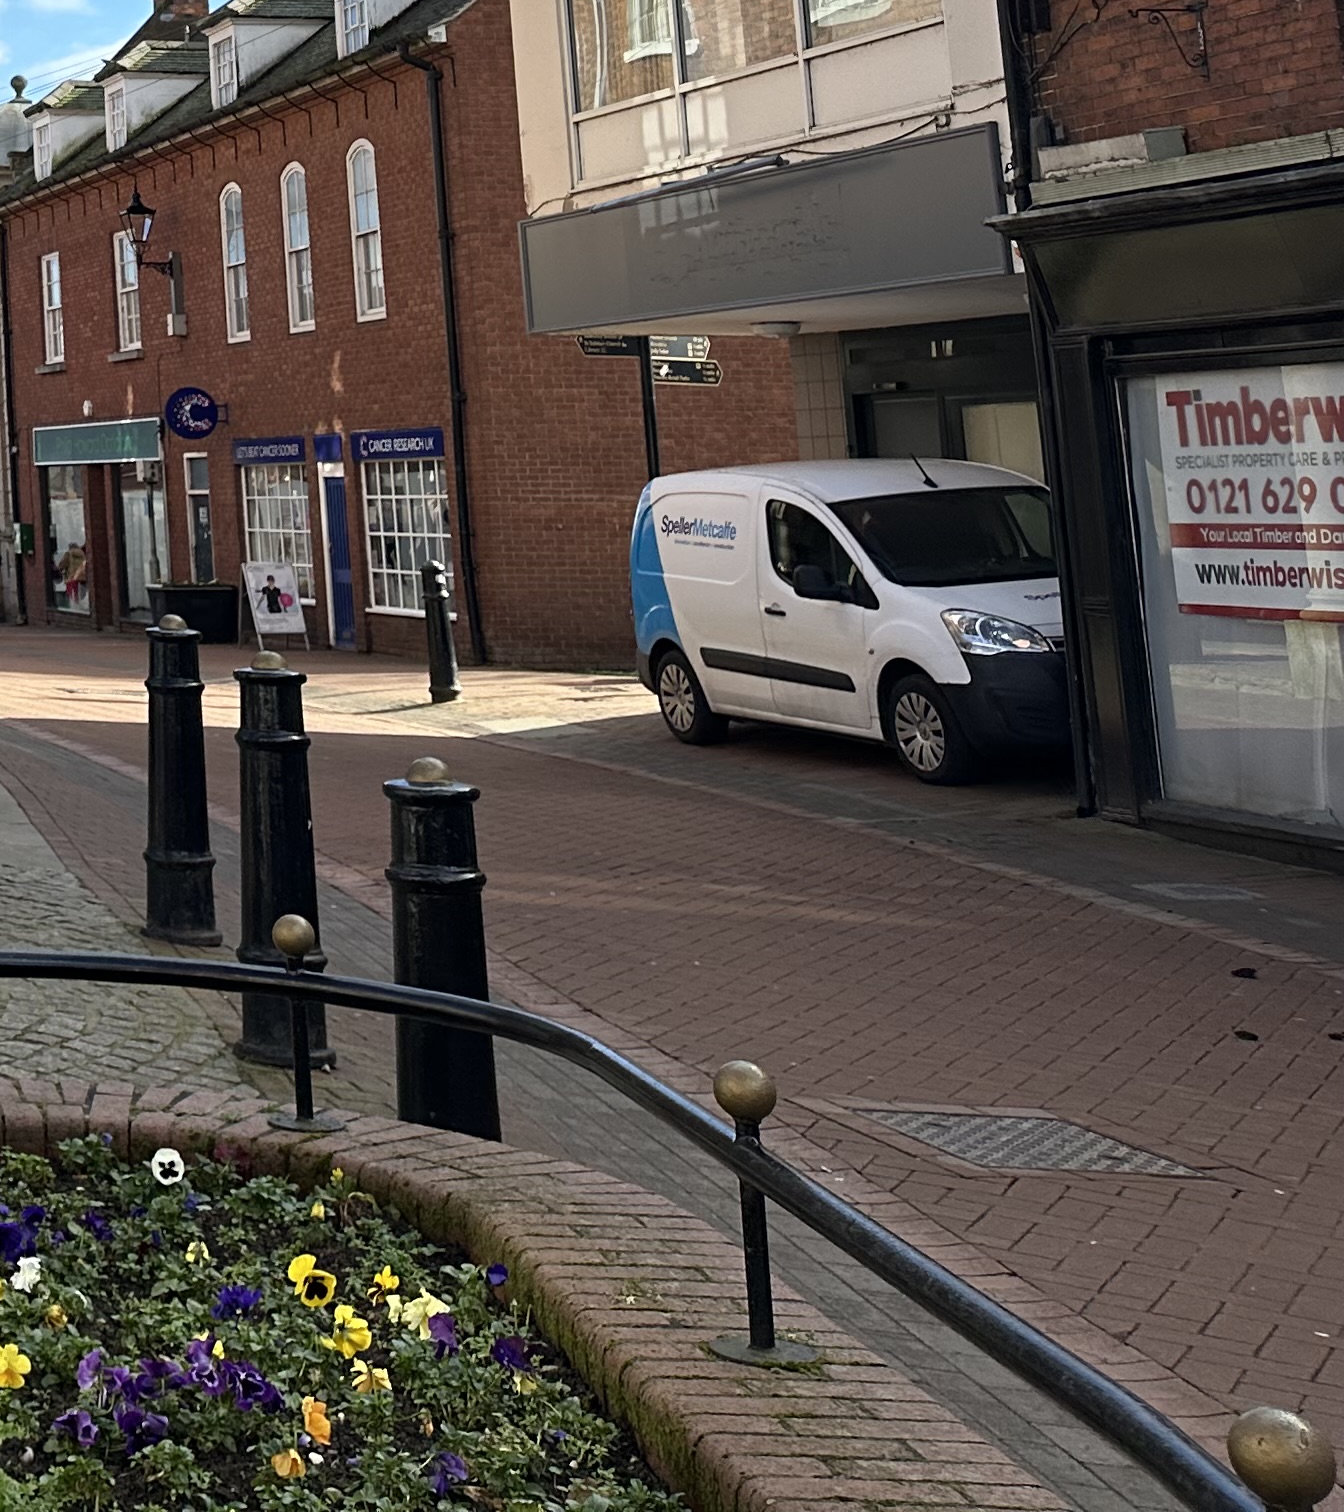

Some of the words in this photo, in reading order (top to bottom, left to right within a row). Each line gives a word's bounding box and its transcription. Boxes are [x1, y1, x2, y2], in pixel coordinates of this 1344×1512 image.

[1165, 386, 1344, 447] Timberw
[368, 439, 392, 452] CANCER
[393, 437, 424, 451] RESEARCH
[1176, 454, 1230, 470] SPECIALIST
[1232, 453, 1286, 469] PROPERTY
[1288, 452, 1317, 467] CARE
[1321, 452, 1332, 466] &
[1185, 477, 1252, 514] 0121
[1261, 476, 1317, 514] 629
[661, 515, 736, 540] SpellerMetcalfe
[1199, 527, 1225, 542] Your
[1226, 527, 1253, 543] Local
[1253, 527, 1292, 544] Timber
[1295, 528, 1316, 544] and
[1320, 529, 1344, 544] Da
[1194, 558, 1344, 589] www.timberwis
